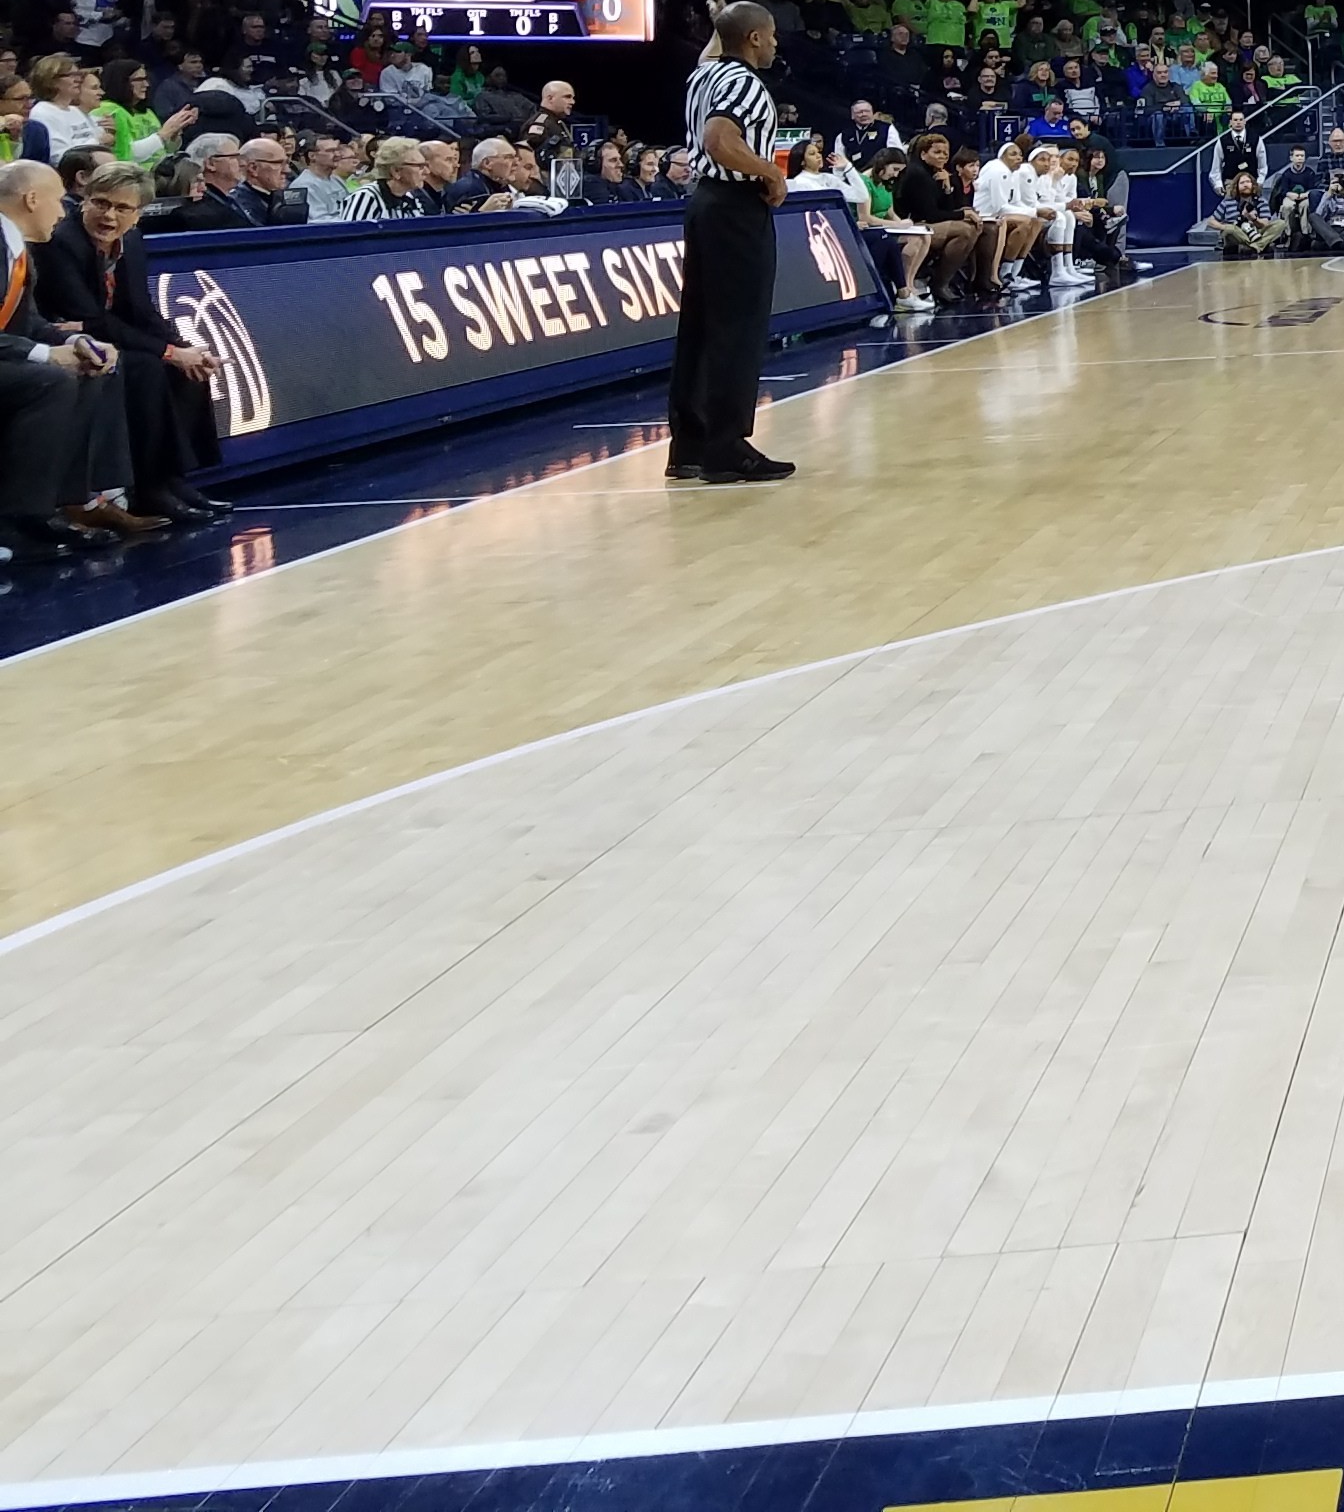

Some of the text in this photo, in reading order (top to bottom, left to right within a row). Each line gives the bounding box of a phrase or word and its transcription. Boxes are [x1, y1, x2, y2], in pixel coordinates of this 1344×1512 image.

[468, 17, 485, 35] 1
[515, 17, 531, 36] 0
[372, 240, 687, 364] 15 SWEET SIXT
